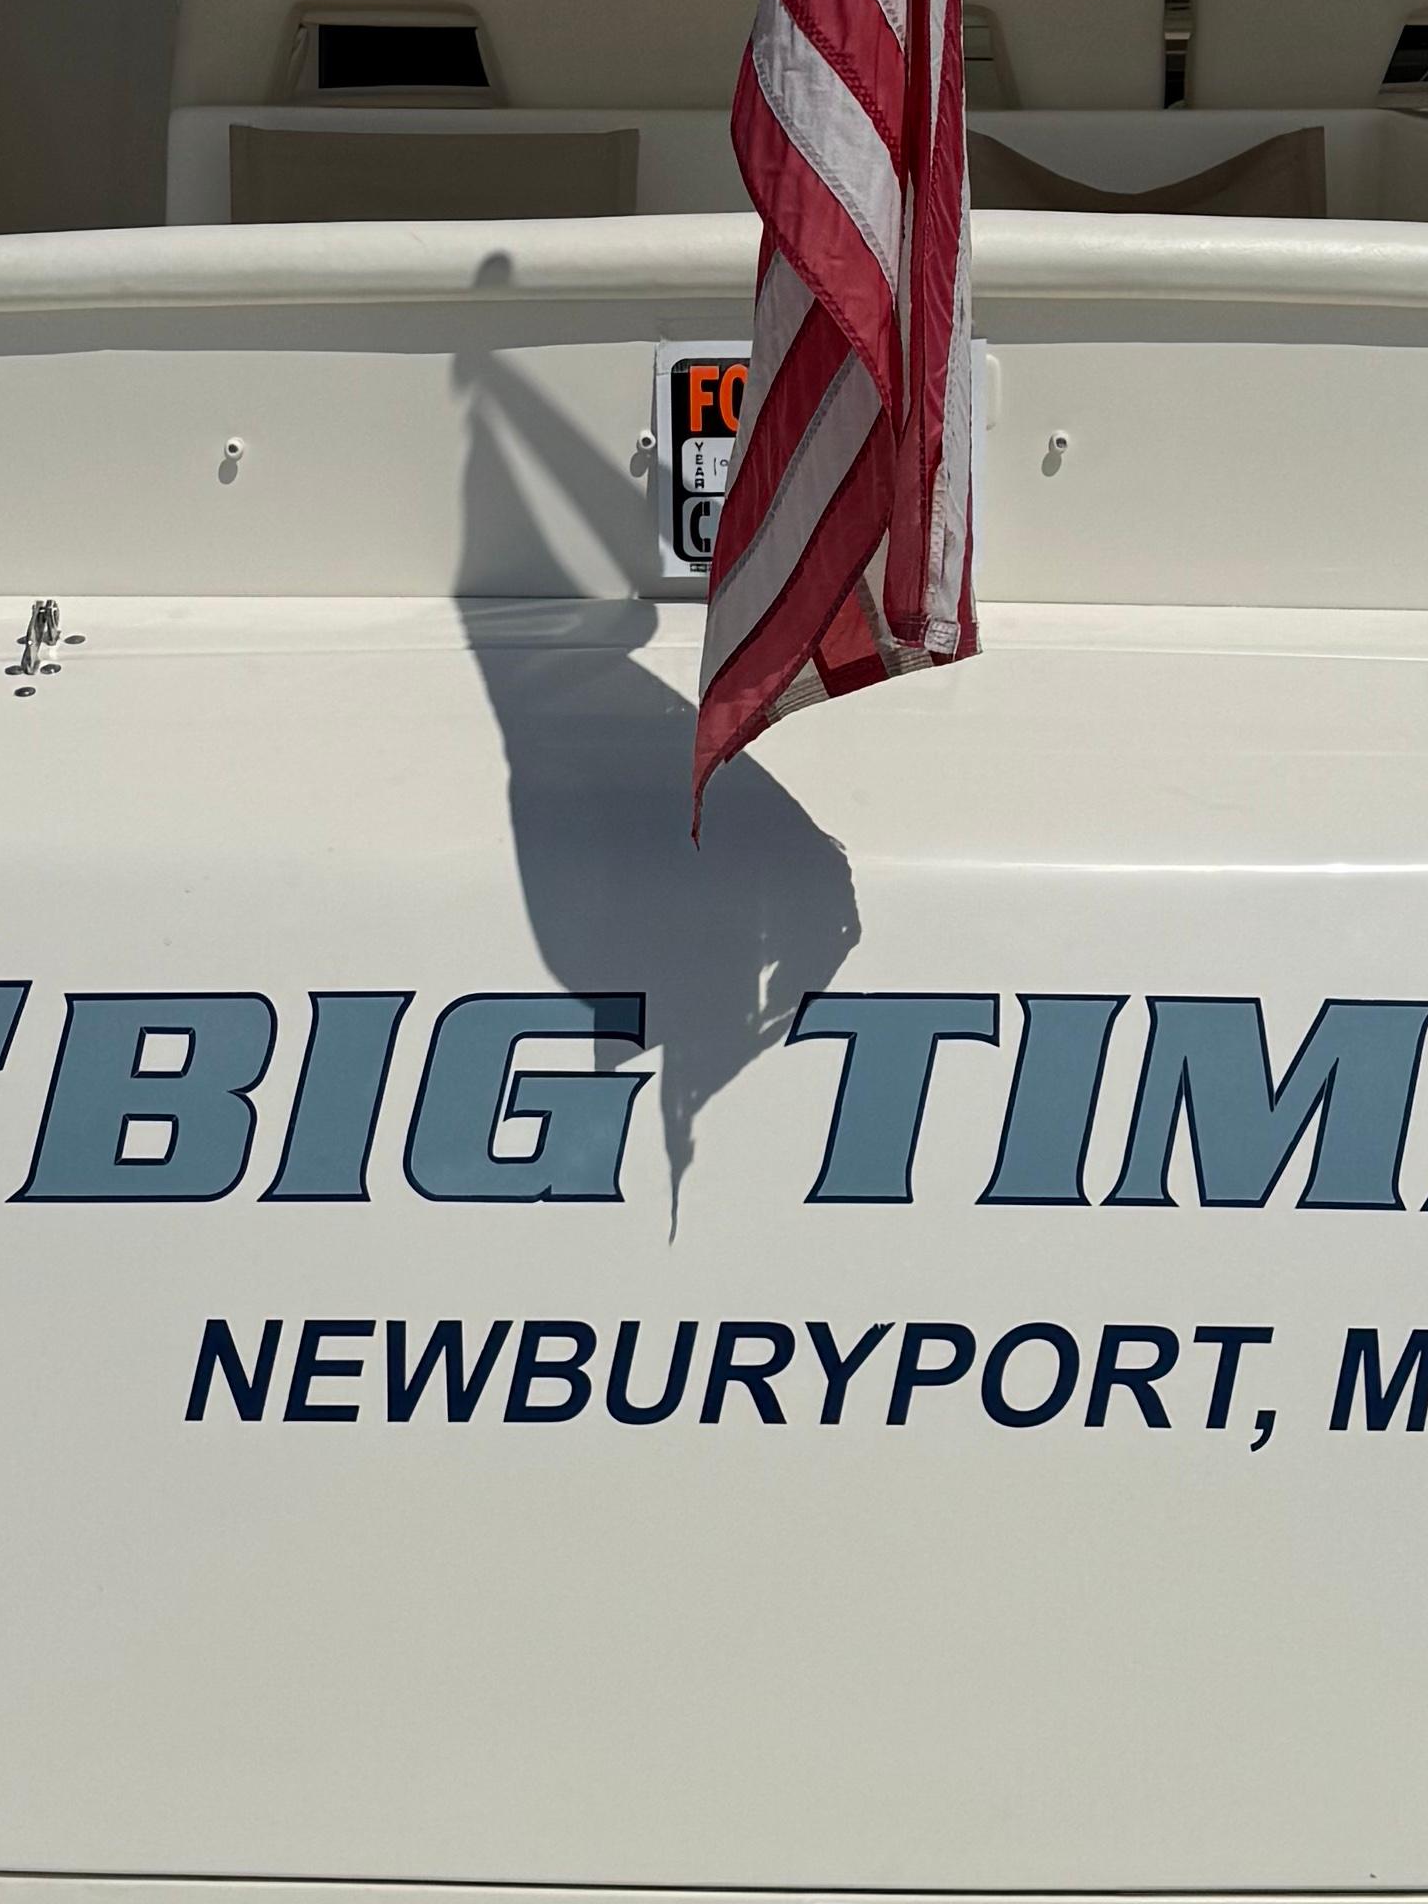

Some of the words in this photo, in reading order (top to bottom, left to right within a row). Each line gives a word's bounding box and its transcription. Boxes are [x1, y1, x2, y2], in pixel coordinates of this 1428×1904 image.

[689, 363, 749, 432] FO
[694, 441, 705, 489] YEAR
[183, 1318, 1275, 1452] NEWBURYPORT,
